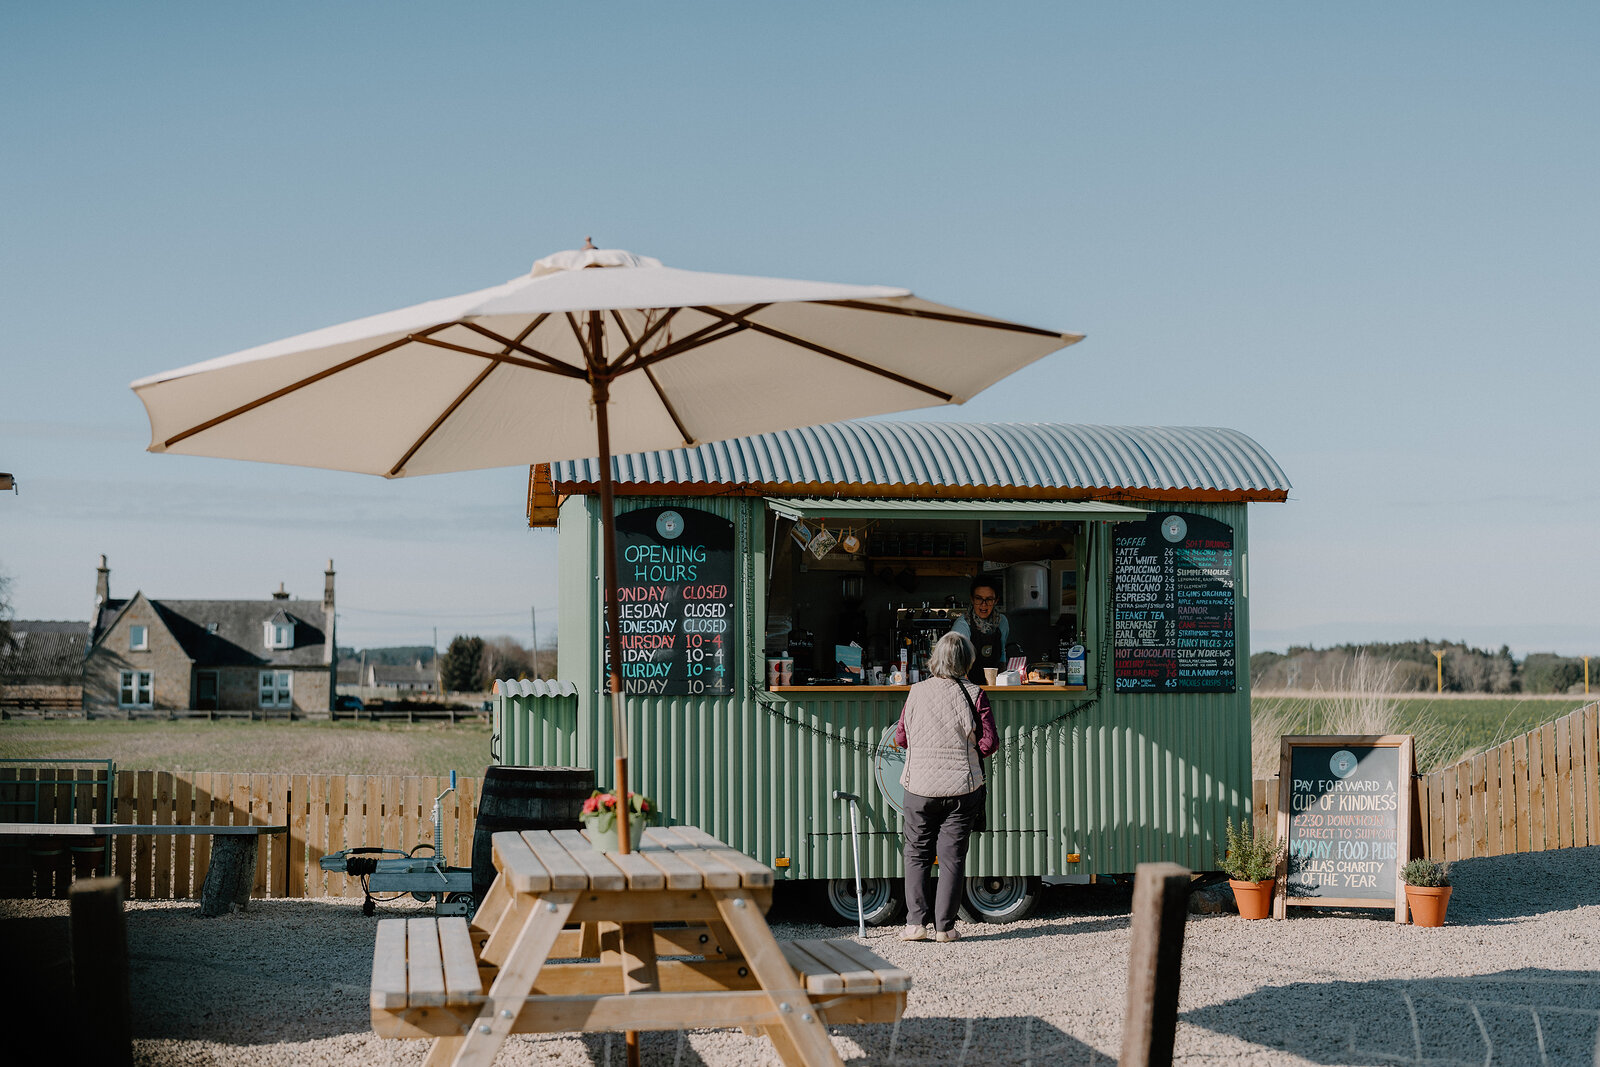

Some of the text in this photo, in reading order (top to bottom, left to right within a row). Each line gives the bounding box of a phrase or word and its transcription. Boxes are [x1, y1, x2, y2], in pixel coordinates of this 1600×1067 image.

[1116, 537, 1147, 546] COFFEE
[1186, 540, 1203, 549] SOFT
[625, 545, 706, 563] OPENING
[1115, 548, 1139, 556] LATTE
[1115, 556, 1133, 565] FLAT
[1135, 556, 1158, 565] WHITE
[635, 565, 697, 582] HOURS
[1115, 565, 1161, 574] CAPPUCCINO
[1115, 574, 1163, 583] MOCHACCINO
[682, 584, 728, 600] CLOSED
[1115, 583, 1161, 592] AMERICANO
[1115, 592, 1157, 602] ESPRESSO
[684, 603, 726, 618] CLOSED
[1115, 611, 1165, 620] ETEAKET TEA
[1178, 606, 1208, 615] RADNOR
[683, 619, 727, 633] CLOSED
[1115, 620, 1158, 630] BREAKFAST
[1115, 629, 1135, 638] EARL
[1138, 629, 1157, 639] GREY
[605, 634, 676, 649] HURSDAY
[1114, 638, 1140, 647] HERBAL
[1177, 638, 1199, 648] FANCY
[605, 649, 656, 664] FIDAY
[1115, 648, 1177, 658] HOT CHOCOLATE
[605, 662, 673, 678] STURDAY
[1178, 669, 1197, 677] KULA
[605, 679, 669, 694] SNDAY
[1293, 779, 1394, 793] PAY FORWARD A
[1320, 794, 1335, 811] OF
[1327, 814, 1385, 827] DONATION
[1298, 827, 1397, 841] DIRECT TO SUPPORT
[1290, 839, 1397, 861] MORAY FOOD PLUS
[1336, 861, 1384, 873] CHARITY
[1301, 872, 1377, 888] OF THE YEAR
